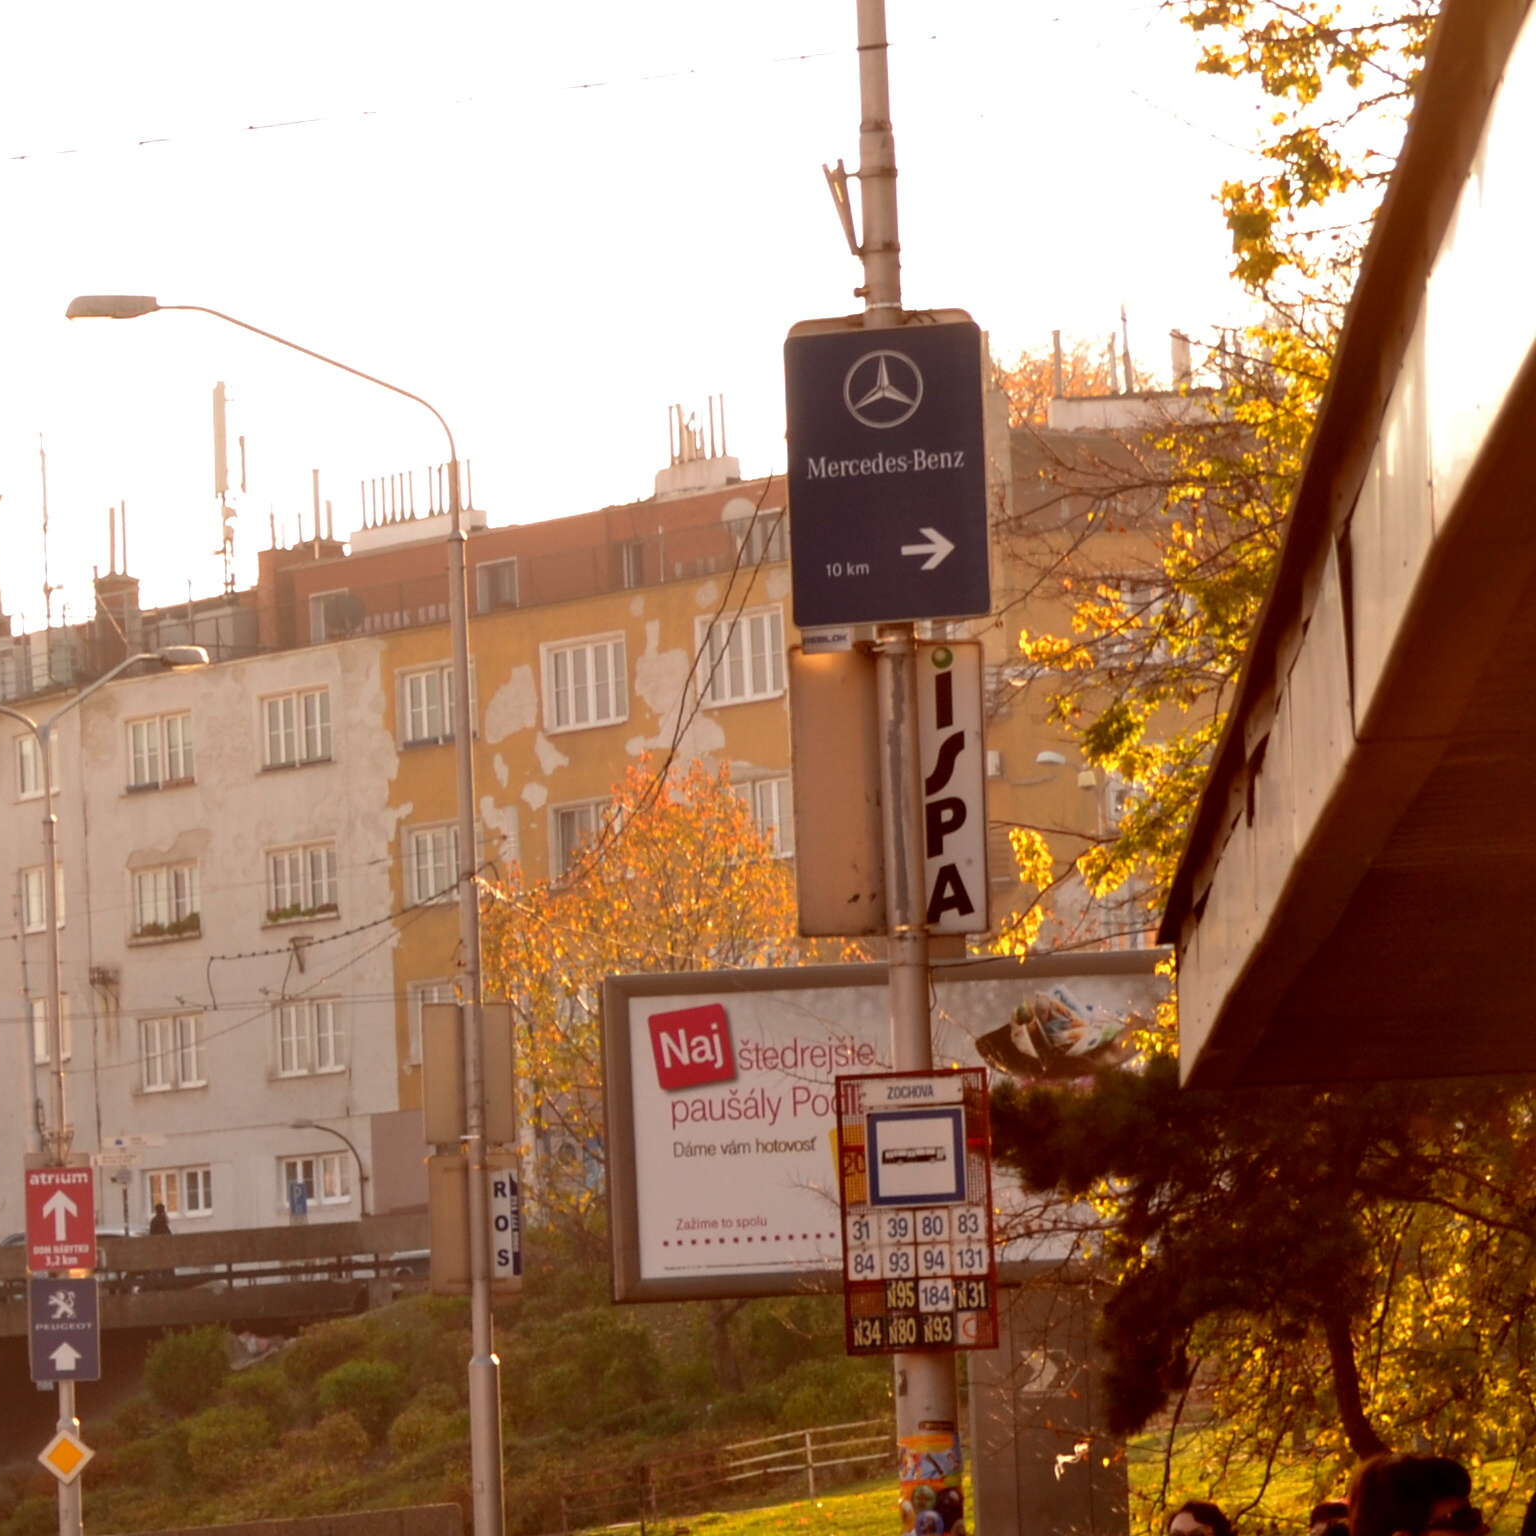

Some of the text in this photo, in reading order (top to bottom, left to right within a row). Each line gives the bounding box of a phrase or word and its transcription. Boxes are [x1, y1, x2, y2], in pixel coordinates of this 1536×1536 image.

[807, 449, 965, 480] Mercedes-Benz
[826, 562, 870, 577] 10 km
[659, 1022, 875, 1074] Naj štedrejšie
[887, 1085, 934, 1100] ZOCHOVA
[671, 1087, 782, 1130] paušály
[673, 1136, 818, 1158] Dáme vám hotovosť
[29, 1172, 88, 1185] atrium
[676, 1215, 768, 1231] Zažime to spolu
[852, 1213, 979, 1241] 31 39 80 83
[62, 1255, 78, 1265] km
[854, 1254, 875, 1274] 84
[889, 1252, 910, 1273] 93
[923, 1250, 945, 1270] 94
[957, 1249, 983, 1269] 131
[887, 1281, 986, 1308] N95 184 N31
[35, 1322, 92, 1331] PEUGEOT
[854, 1316, 952, 1347] N34 N80 N93
